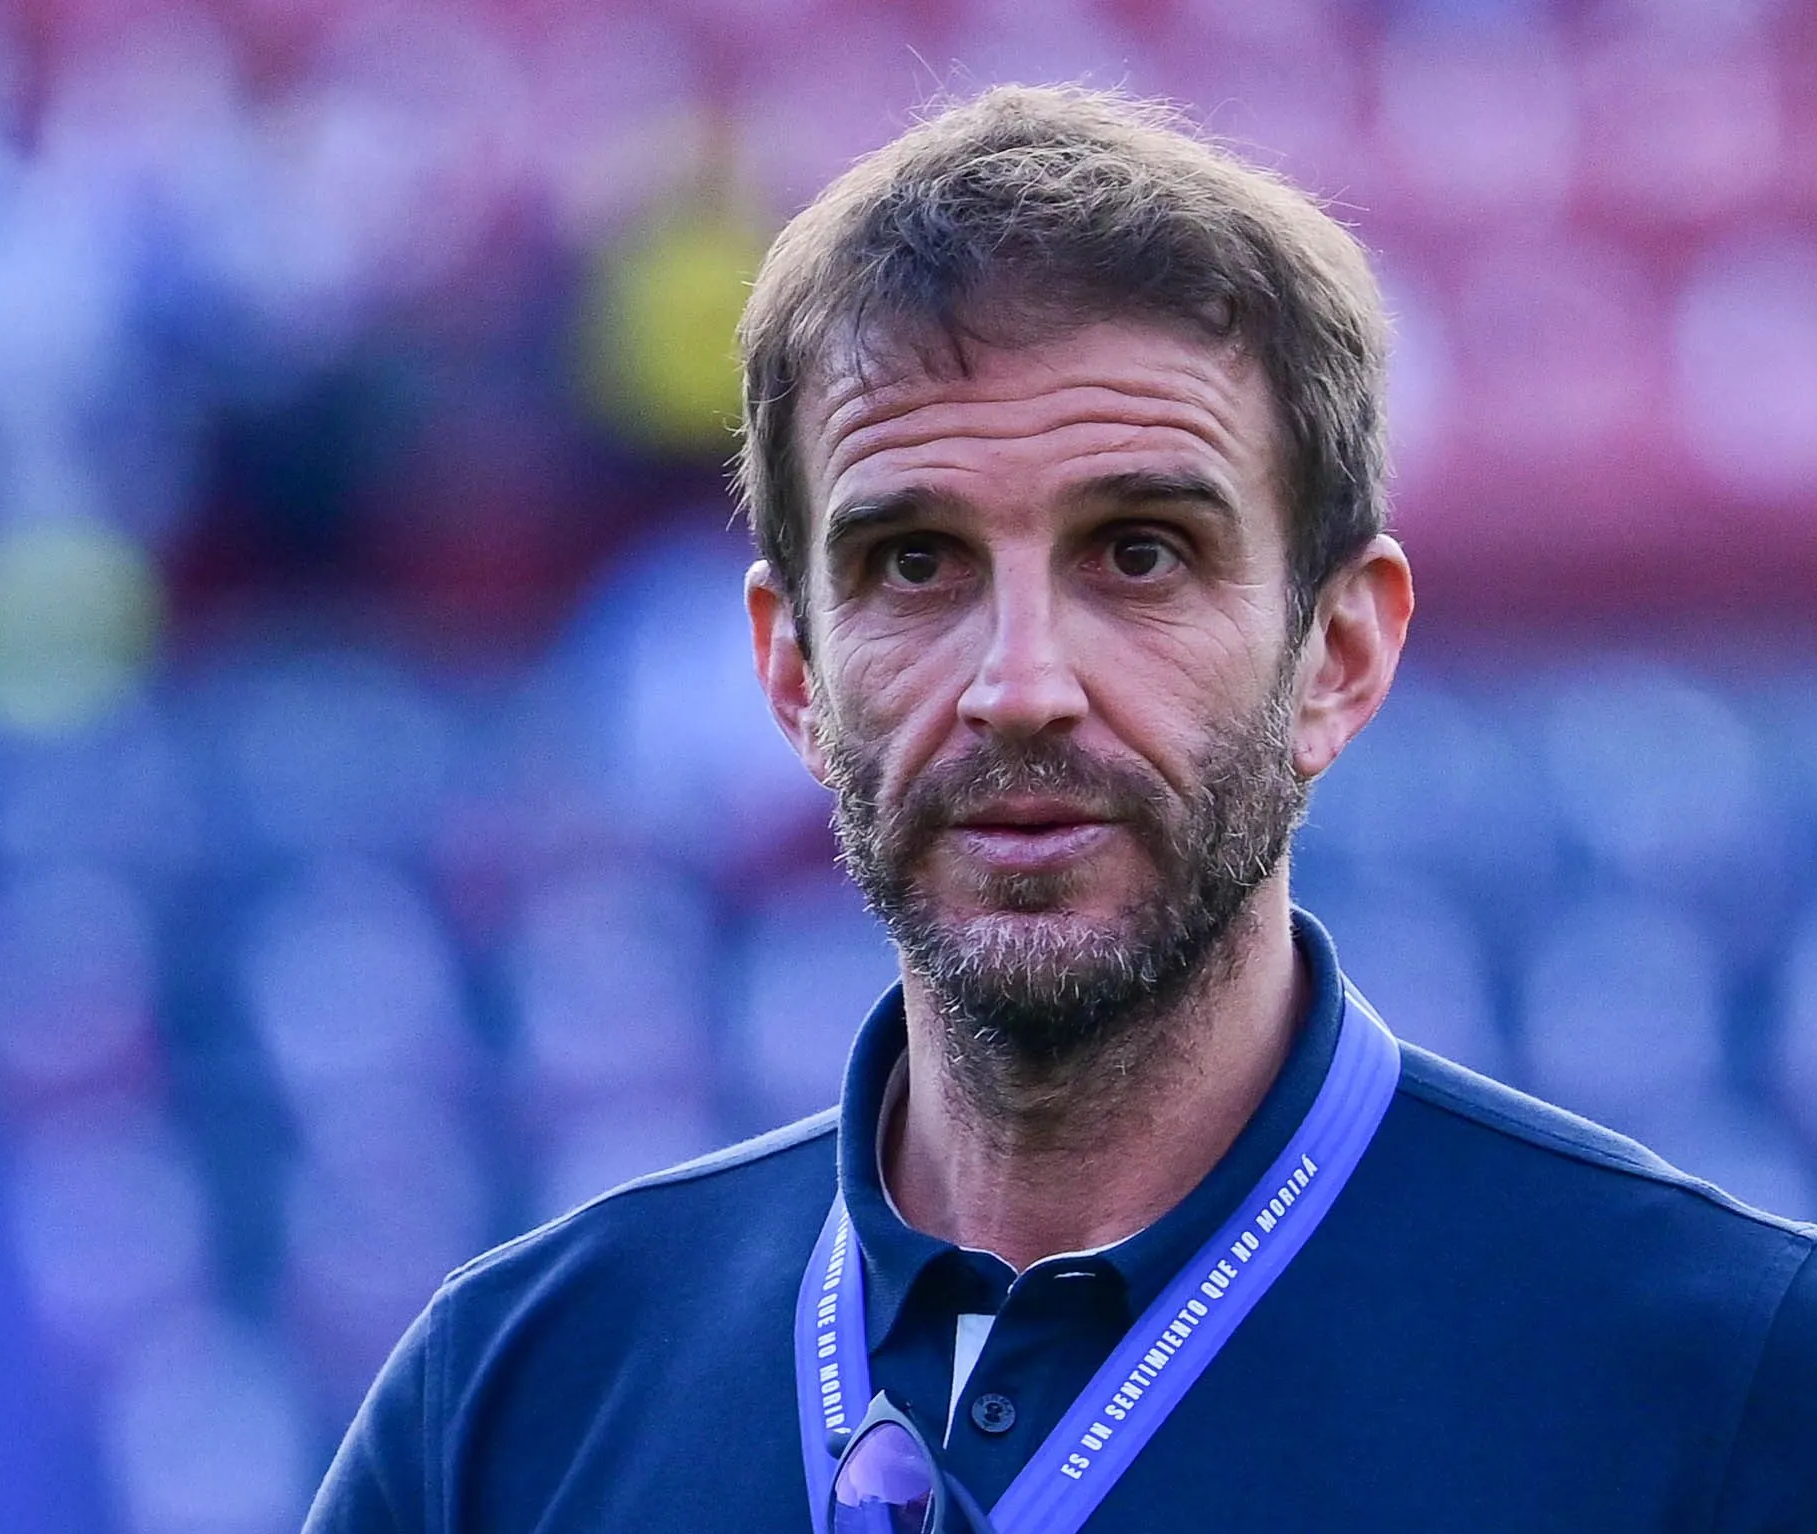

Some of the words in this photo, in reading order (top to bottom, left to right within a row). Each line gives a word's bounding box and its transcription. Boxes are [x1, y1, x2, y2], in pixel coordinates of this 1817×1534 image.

[816, 1293, 839, 1328] QUE
[1060, 1451, 1091, 1480] ES
[1080, 1421, 1113, 1452] UN
[1104, 1299, 1209, 1422] SENTIMIENTO
[1200, 1259, 1239, 1300] QUE
[1230, 1230, 1261, 1263] NO
[1254, 1153, 1319, 1234] MORIRÁ
[817, 1330, 837, 1359] NO
